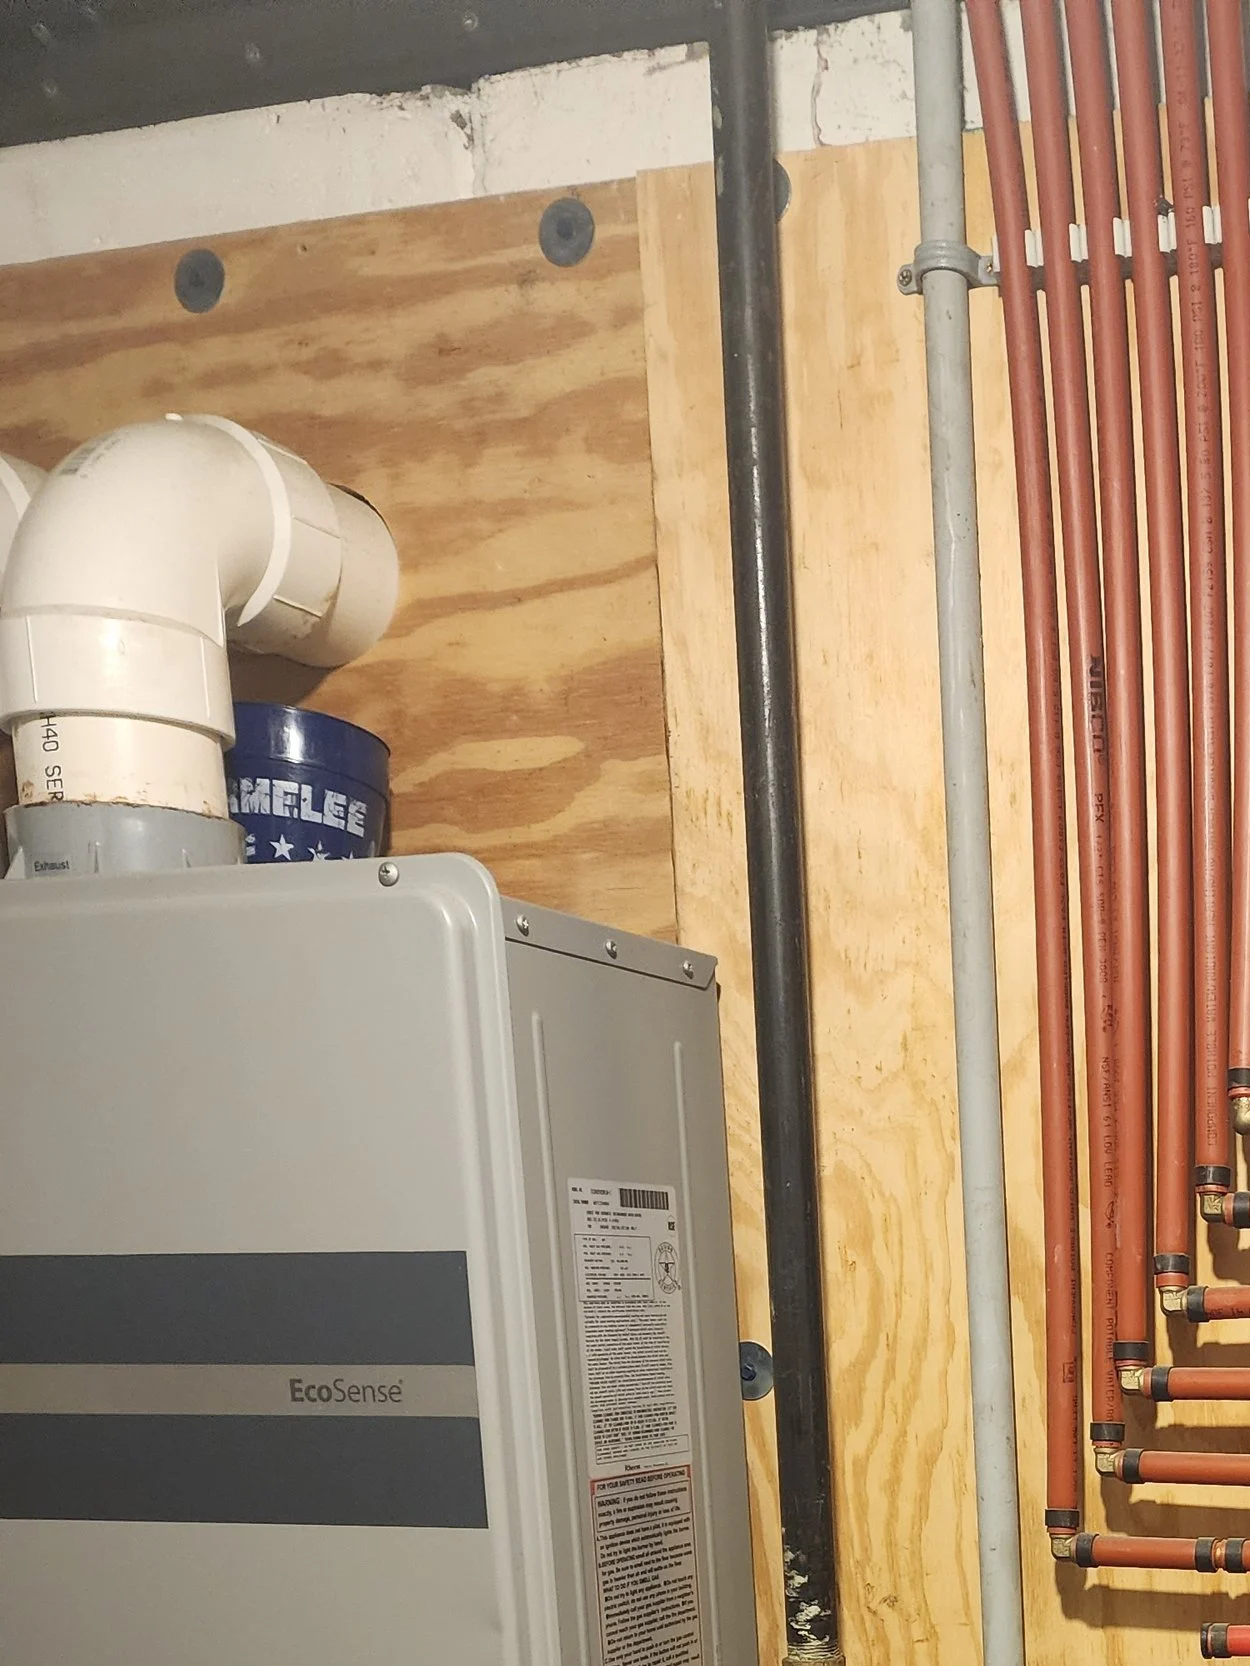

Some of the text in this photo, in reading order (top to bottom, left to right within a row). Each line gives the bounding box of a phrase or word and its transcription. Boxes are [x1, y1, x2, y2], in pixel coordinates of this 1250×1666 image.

[40, 712, 64, 800] H40 SER
[34, 861, 70, 872] Exhaust
[288, 1378, 403, 1403] EcoSense
